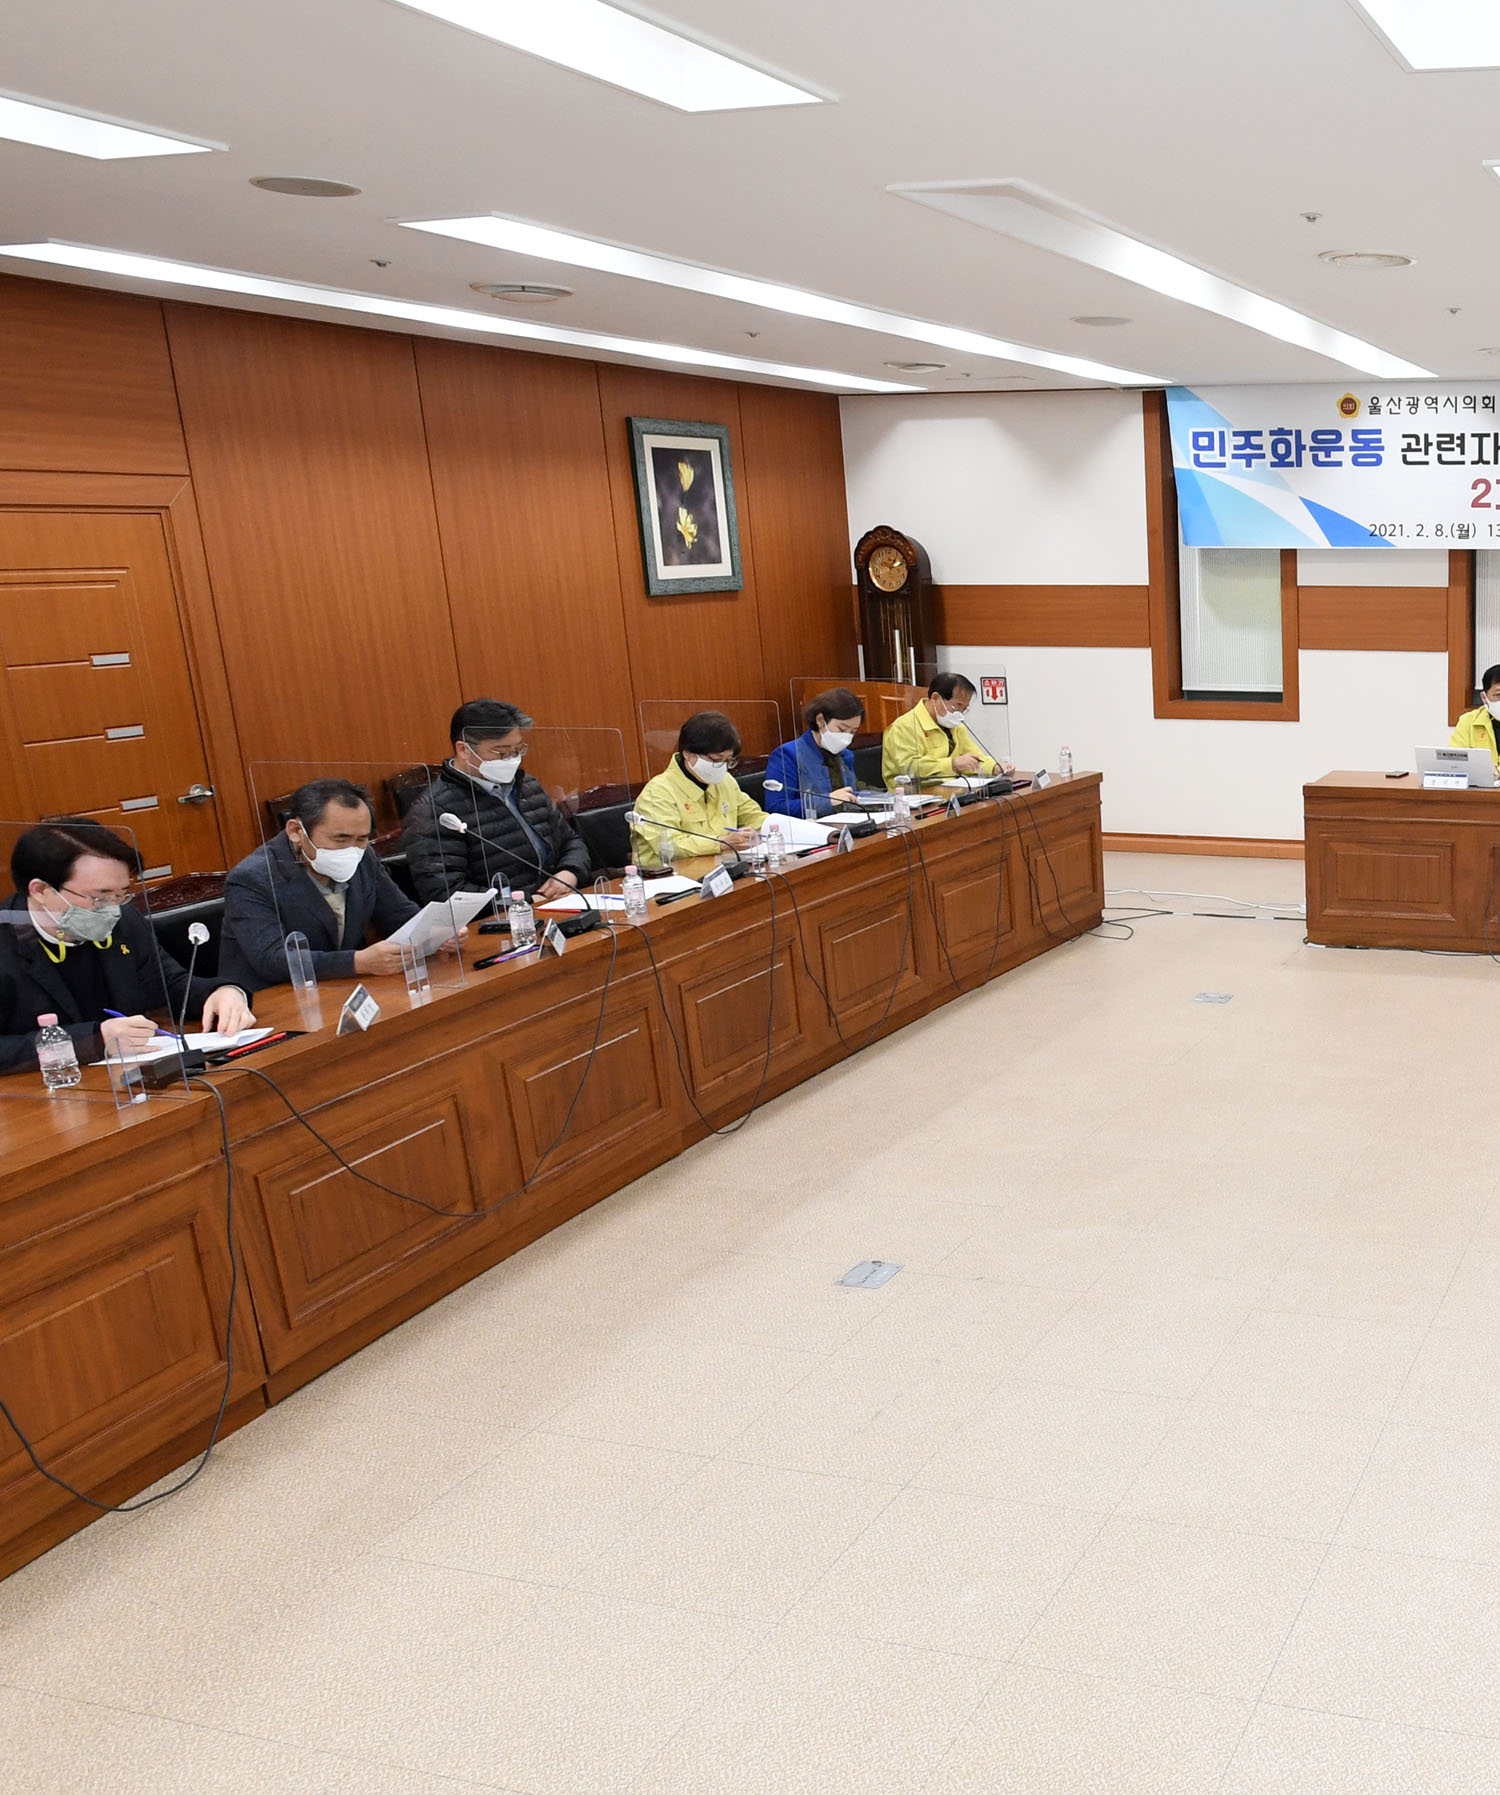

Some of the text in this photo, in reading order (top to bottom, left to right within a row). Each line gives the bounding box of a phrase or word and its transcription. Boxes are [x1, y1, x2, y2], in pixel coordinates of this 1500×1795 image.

[1367, 395, 1496, 415] 울산광역시의회
[1191, 427, 1385, 468] 민주화운동
[1368, 524, 1410, 539] 2021.
[1415, 524, 1429, 538] 2.
[1434, 523, 1476, 540] 8.(월)
